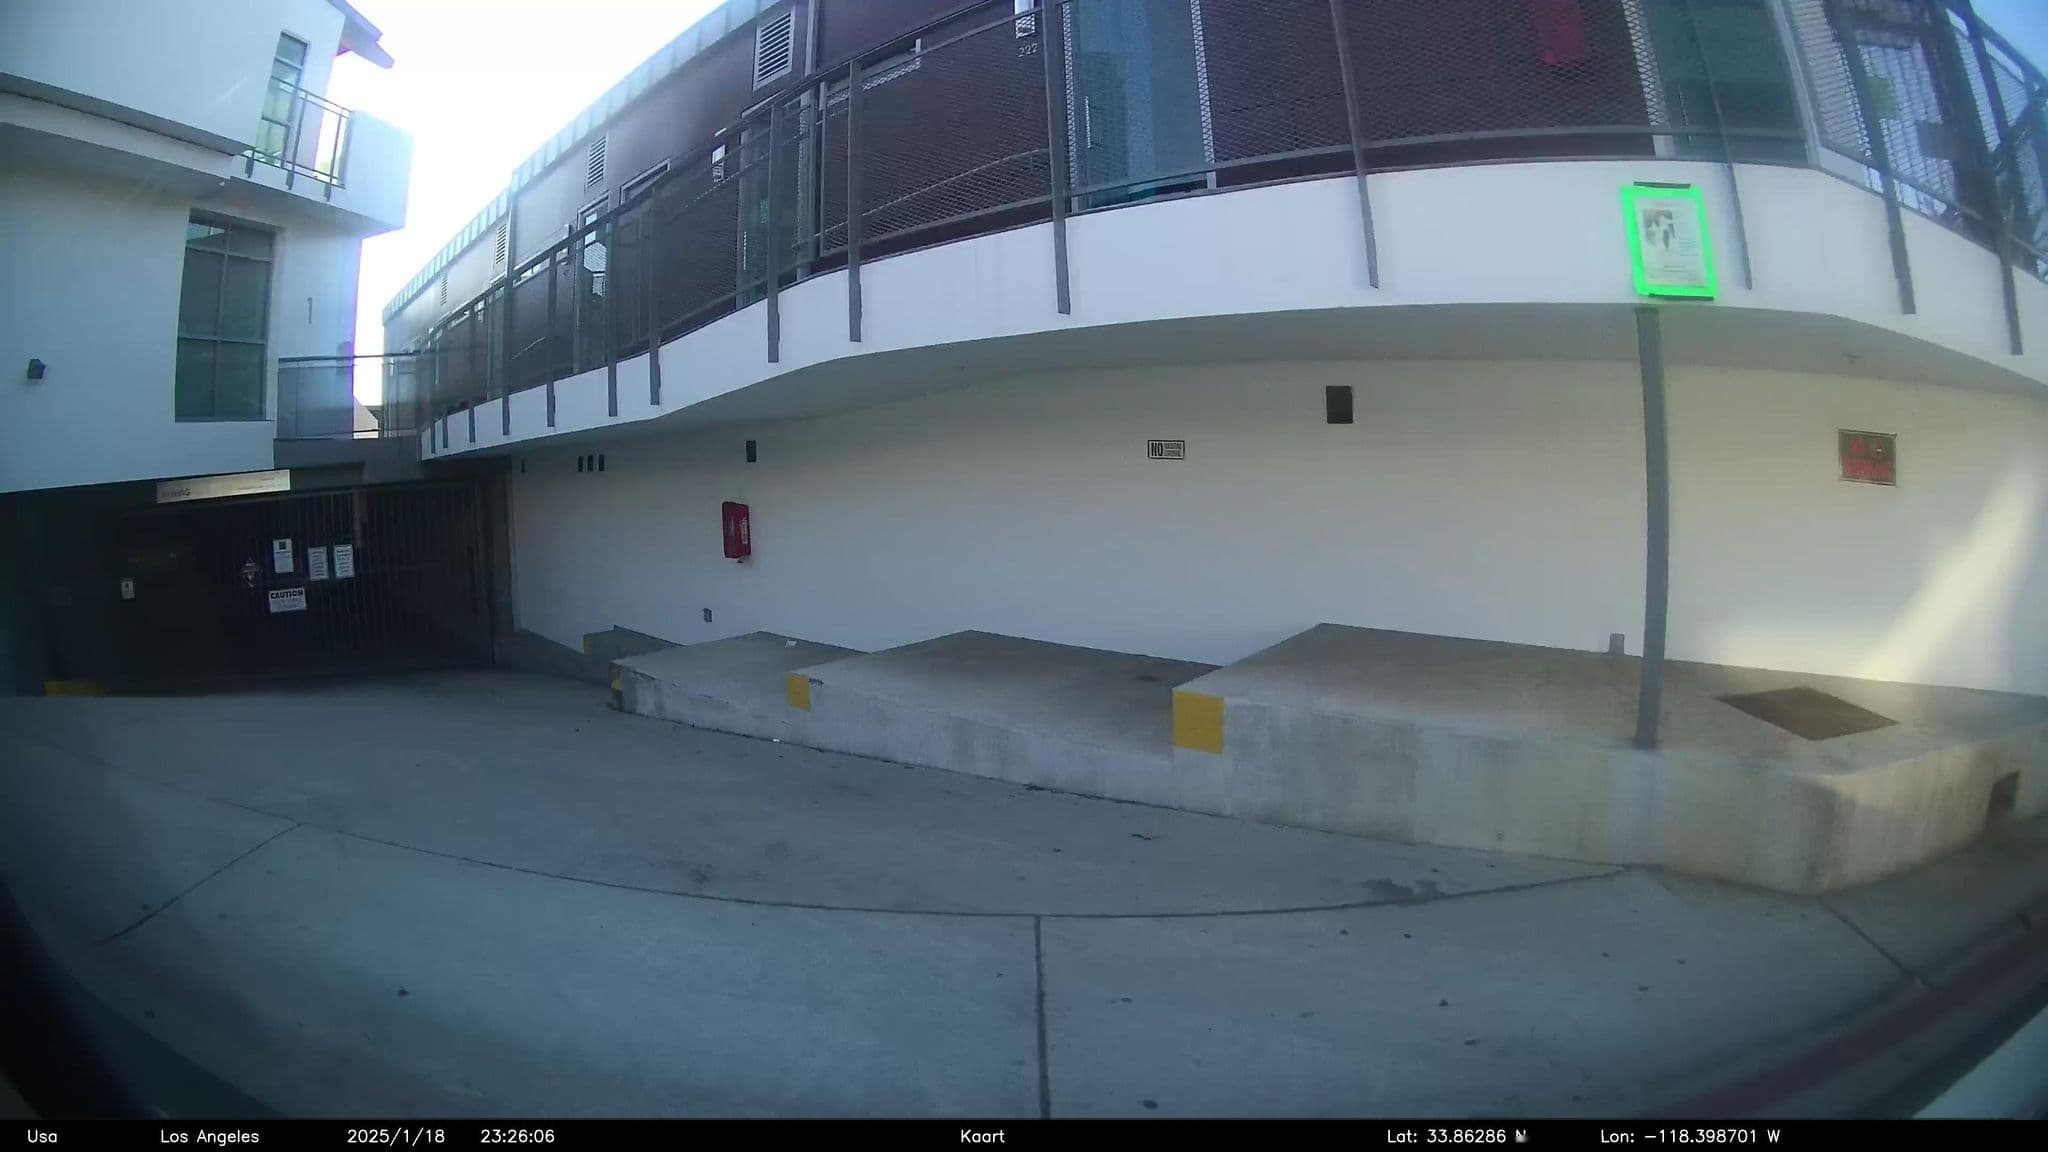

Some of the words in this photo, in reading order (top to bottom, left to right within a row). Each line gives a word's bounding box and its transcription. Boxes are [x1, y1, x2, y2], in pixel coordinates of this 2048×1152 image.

[306, 296, 313, 325] 1
[1151, 442, 1164, 457] NO
[270, 589, 304, 600] CAUTION
